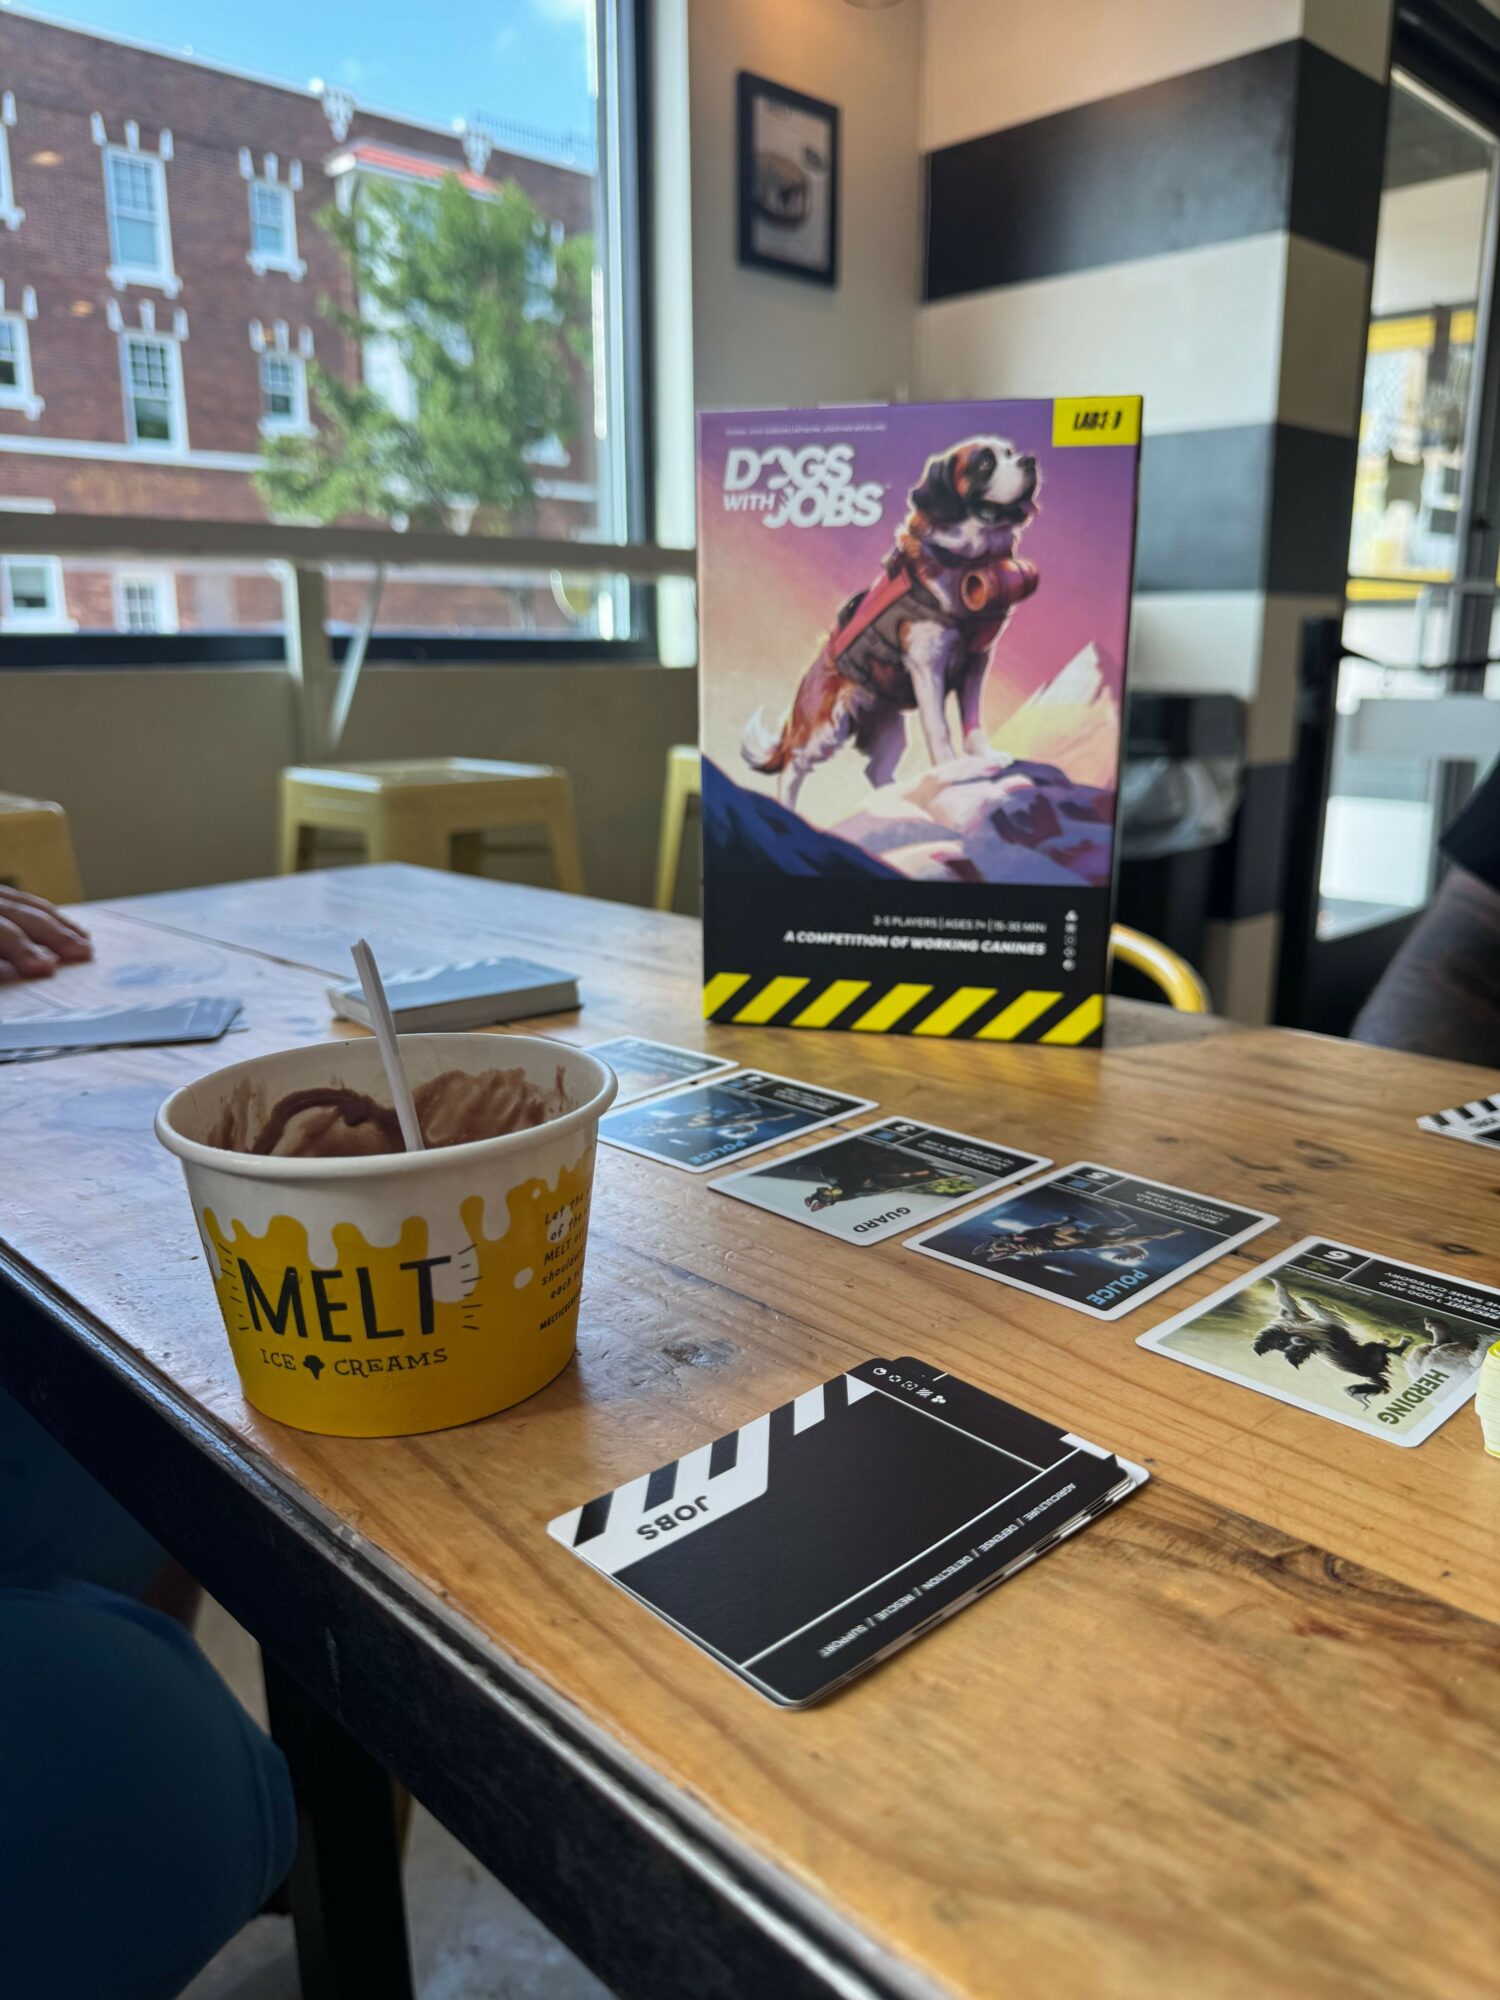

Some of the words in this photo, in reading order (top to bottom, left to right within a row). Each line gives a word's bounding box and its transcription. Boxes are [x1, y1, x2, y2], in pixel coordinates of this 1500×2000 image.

[723, 444, 855, 491] DOGS
[723, 493, 776, 511] WITH
[762, 481, 885, 529] JOBS
[892, 915, 938, 929] PLAYERS
[944, 917, 973, 931] AGES
[1022, 921, 1047, 934] MIN
[784, 929, 795, 943] A
[796, 930, 890, 948] COMPETITION
[890, 935, 909, 949] OF
[910, 936, 979, 953] WORKING
[980, 939, 1047, 956] CANINES
[689, 1139, 747, 1165] POLICE
[550, 1223, 564, 1241] of
[852, 1206, 911, 1233] GUARD
[543, 1238, 572, 1266] MELT
[550, 1276, 571, 1299] each
[1086, 1269, 1149, 1305] POLICE
[1379, 1281, 1407, 1293] AND
[1384, 1271, 1447, 1292] CATEGORY
[1391, 1279, 1409, 1287] OF
[1407, 1289, 1435, 1301] DOG
[1408, 1284, 1444, 1297] DOGS
[237, 1256, 452, 1342] MELT
[1444, 1296, 1473, 1305] ANY
[1448, 1290, 1483, 1303] SAME
[1443, 1301, 1500, 1320] RECRUIT
[260, 1348, 297, 1371] ICE
[334, 1348, 448, 1379] CREAMS
[1378, 1368, 1449, 1426] HERDING
[1023, 1482, 1076, 1521] AGRICULTURE
[636, 1495, 709, 1541] JOBS
[978, 1523, 1019, 1553] DEFENSE
[921, 1555, 975, 1590] DETECTION
[874, 1593, 917, 1621] RESCUE
[818, 1624, 869, 1658] SUPPORT
